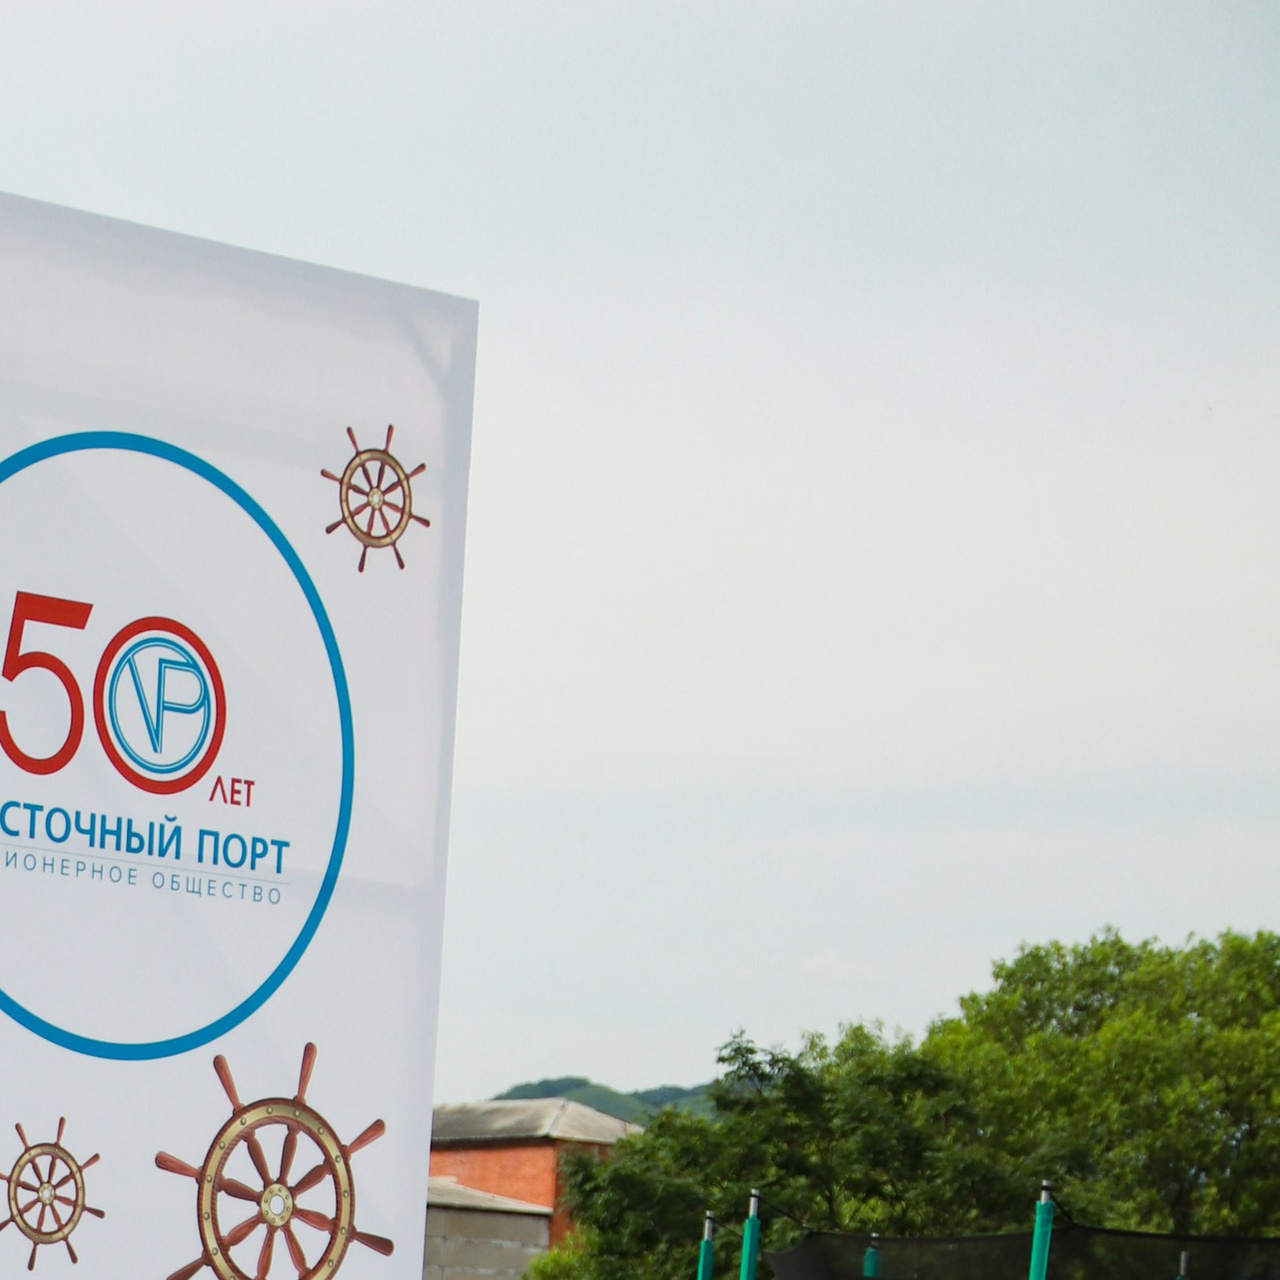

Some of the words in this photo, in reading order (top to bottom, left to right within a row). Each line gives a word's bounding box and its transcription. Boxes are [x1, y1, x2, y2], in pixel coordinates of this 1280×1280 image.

[209, 775, 255, 807] ЛЕТ
[197, 829, 290, 874] ПОРТ
[152, 871, 282, 904] ОБЩЕСТВО
